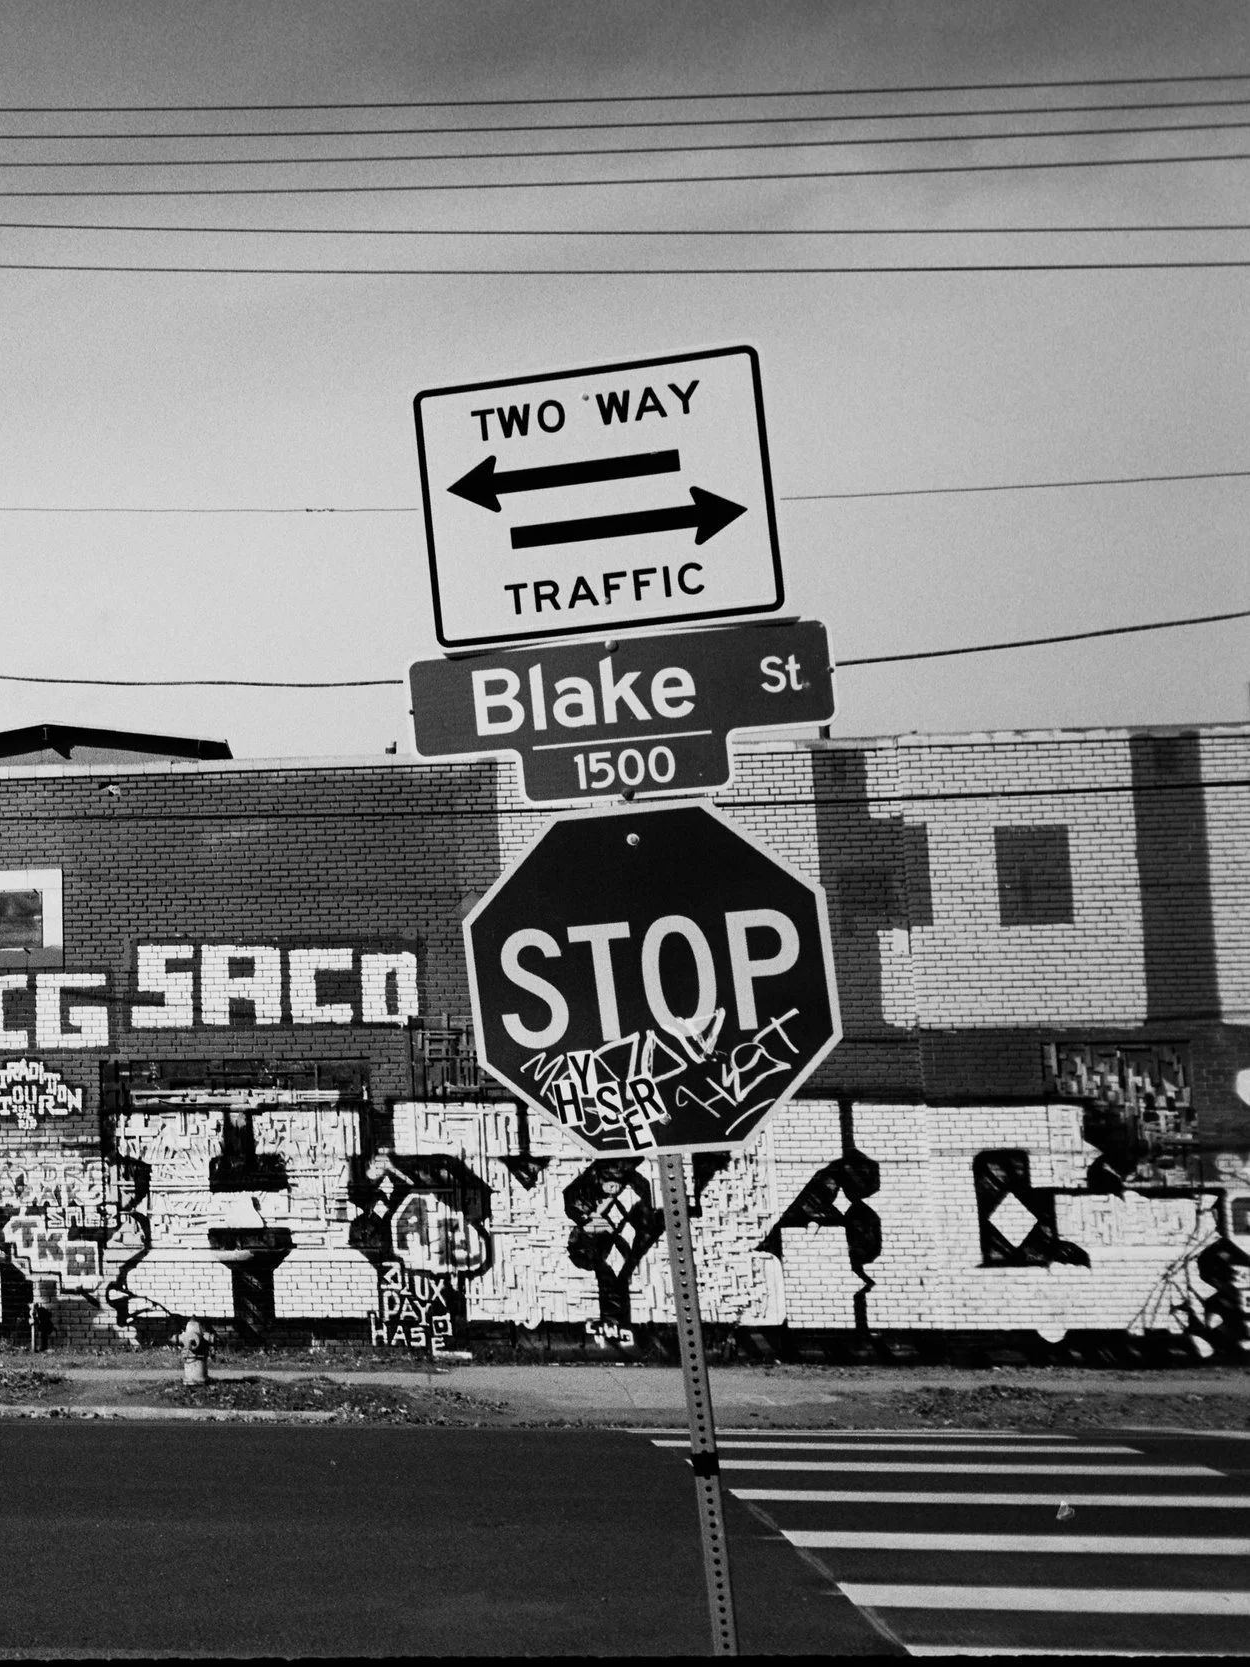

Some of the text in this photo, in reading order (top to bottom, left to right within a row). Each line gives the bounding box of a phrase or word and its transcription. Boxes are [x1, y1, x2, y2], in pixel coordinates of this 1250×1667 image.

[471, 380, 700, 441] TWO WAY
[504, 562, 706, 615] TRAFFIC
[471, 653, 803, 737] Blake St
[573, 745, 677, 790] 1500
[499, 908, 801, 1049] STOP
